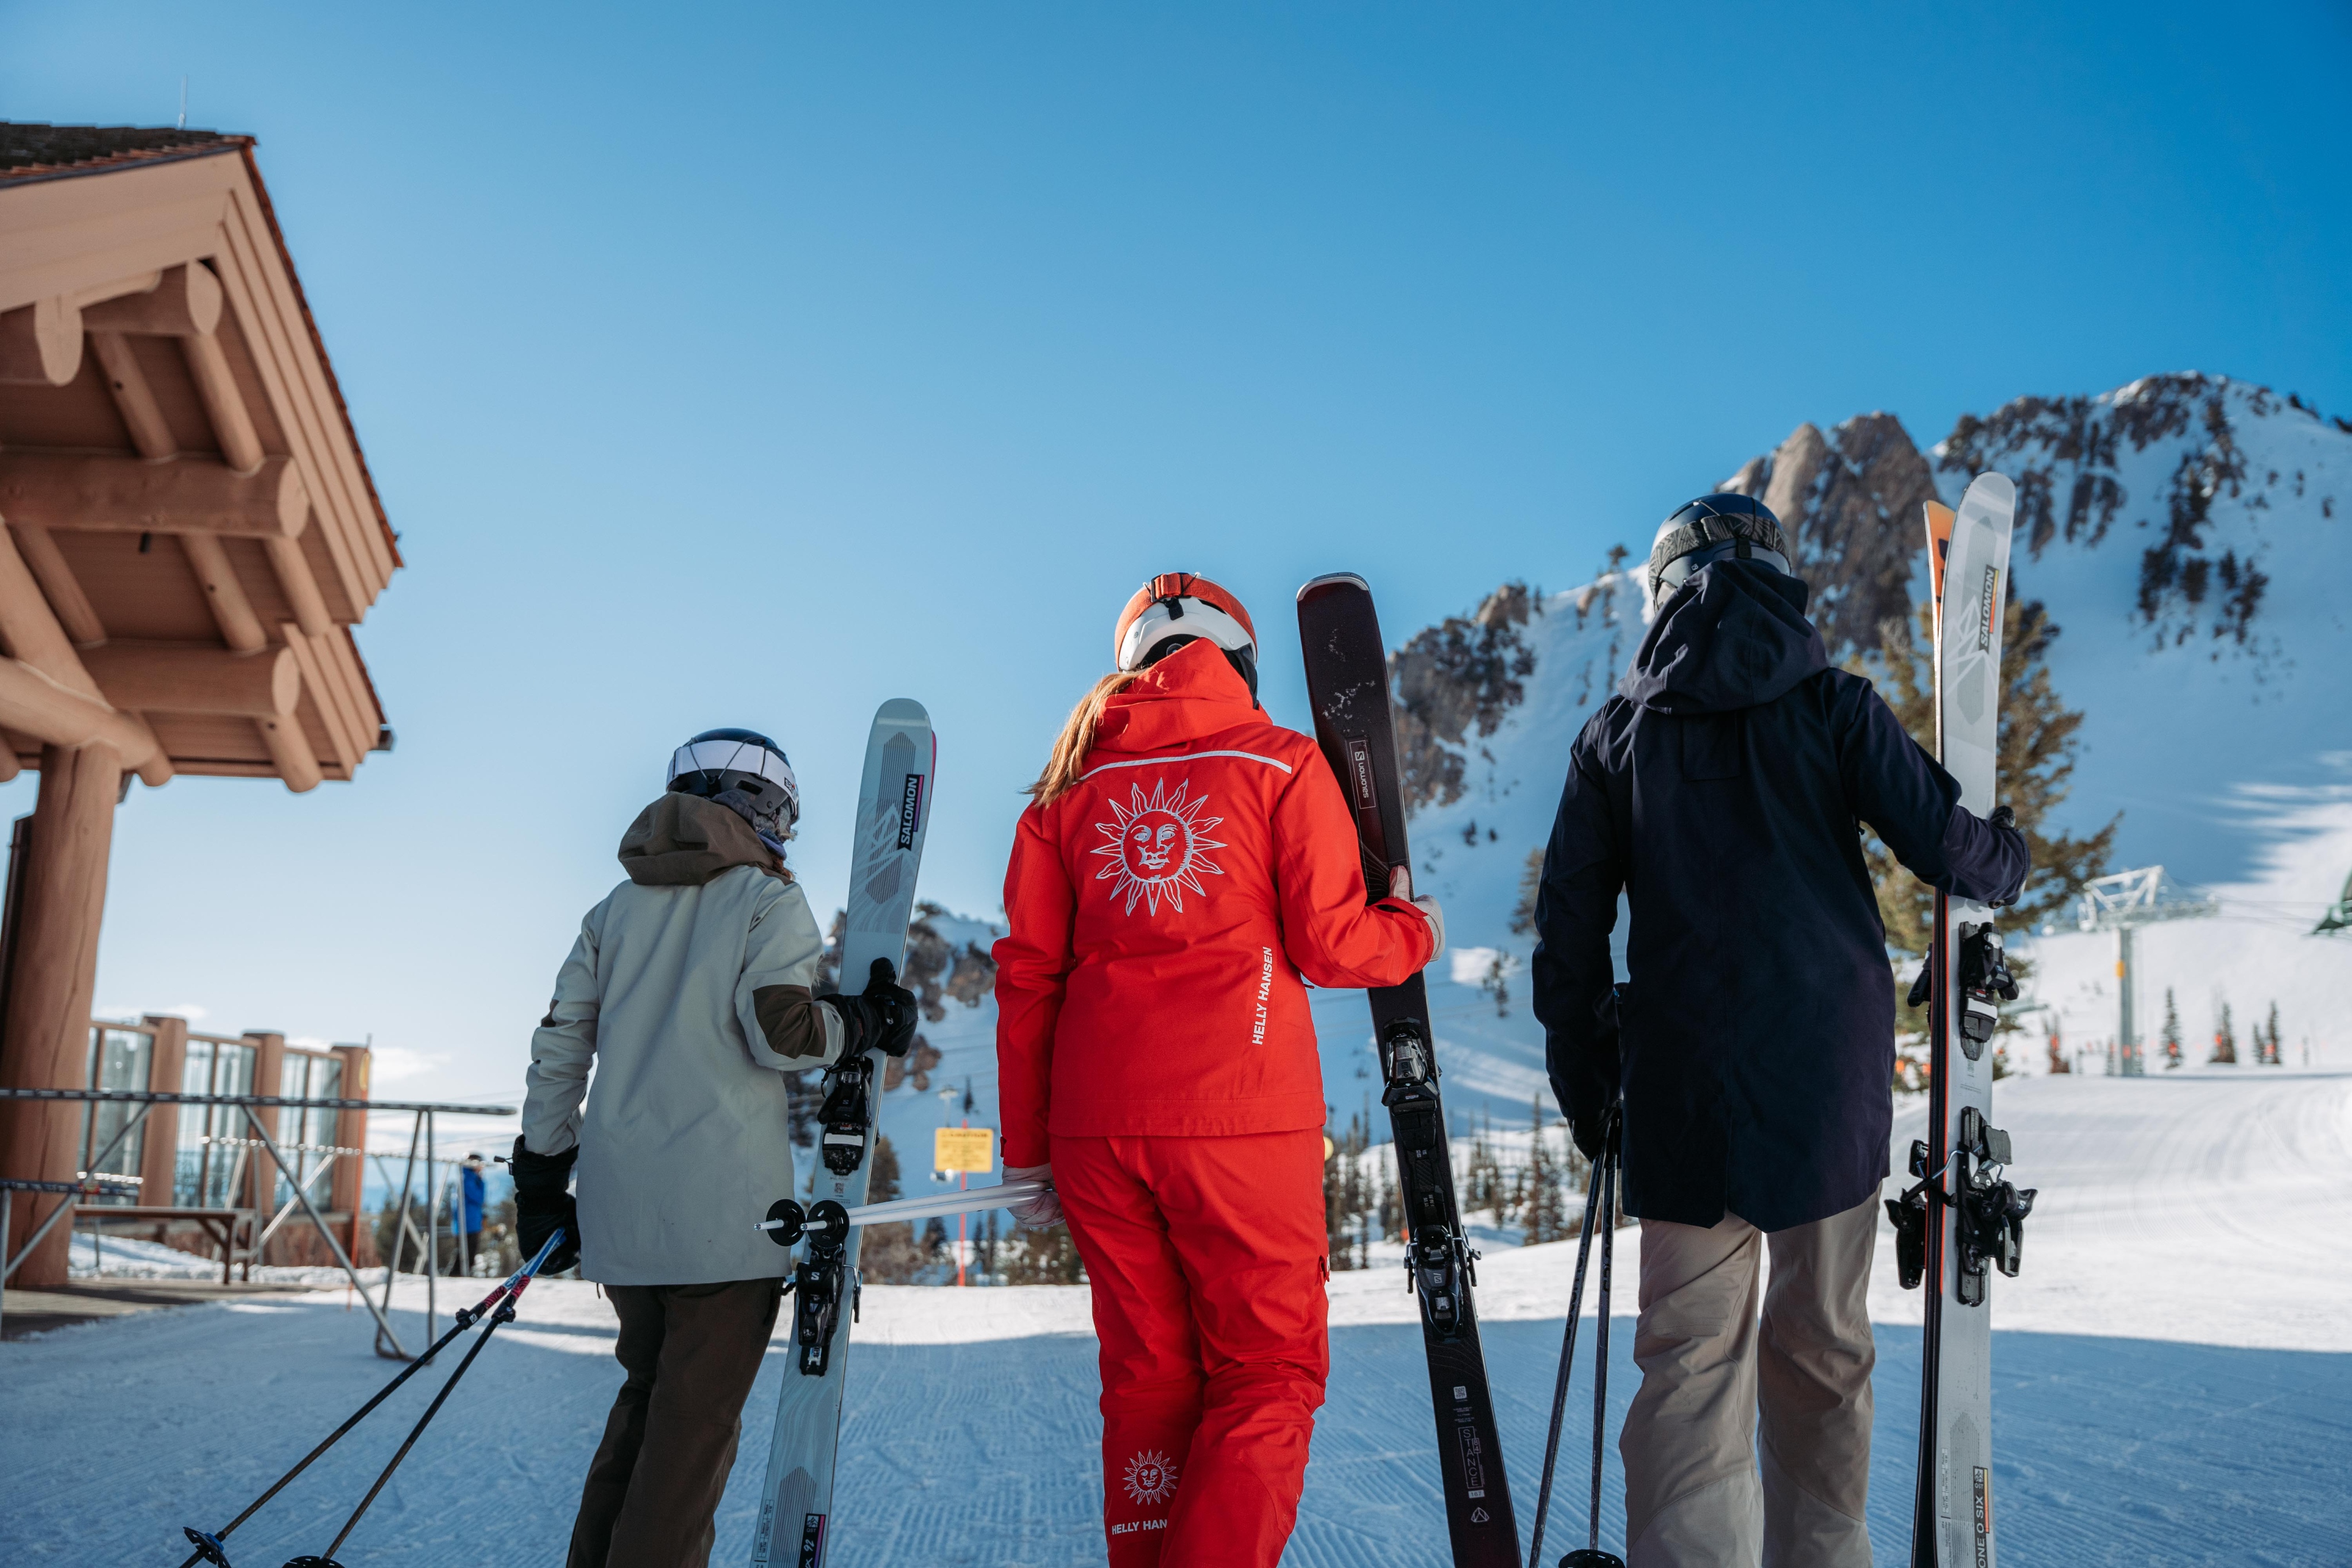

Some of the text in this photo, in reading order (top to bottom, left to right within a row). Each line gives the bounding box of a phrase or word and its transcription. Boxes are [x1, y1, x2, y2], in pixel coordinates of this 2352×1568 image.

[1980, 568, 1994, 648] SALOMON
[901, 777, 918, 845] SALOMON
[1252, 946, 1273, 1045] HELLY HANSEN
[1463, 1429, 1479, 1486] STANCE
[1473, 1439, 1479, 1451] 84
[1975, 1495, 1984, 1519] SIX
[1112, 1519, 1167, 1535] HELLY HAN
[804, 1539, 814, 1551] 92
[1977, 1537, 1986, 1568] ONE
